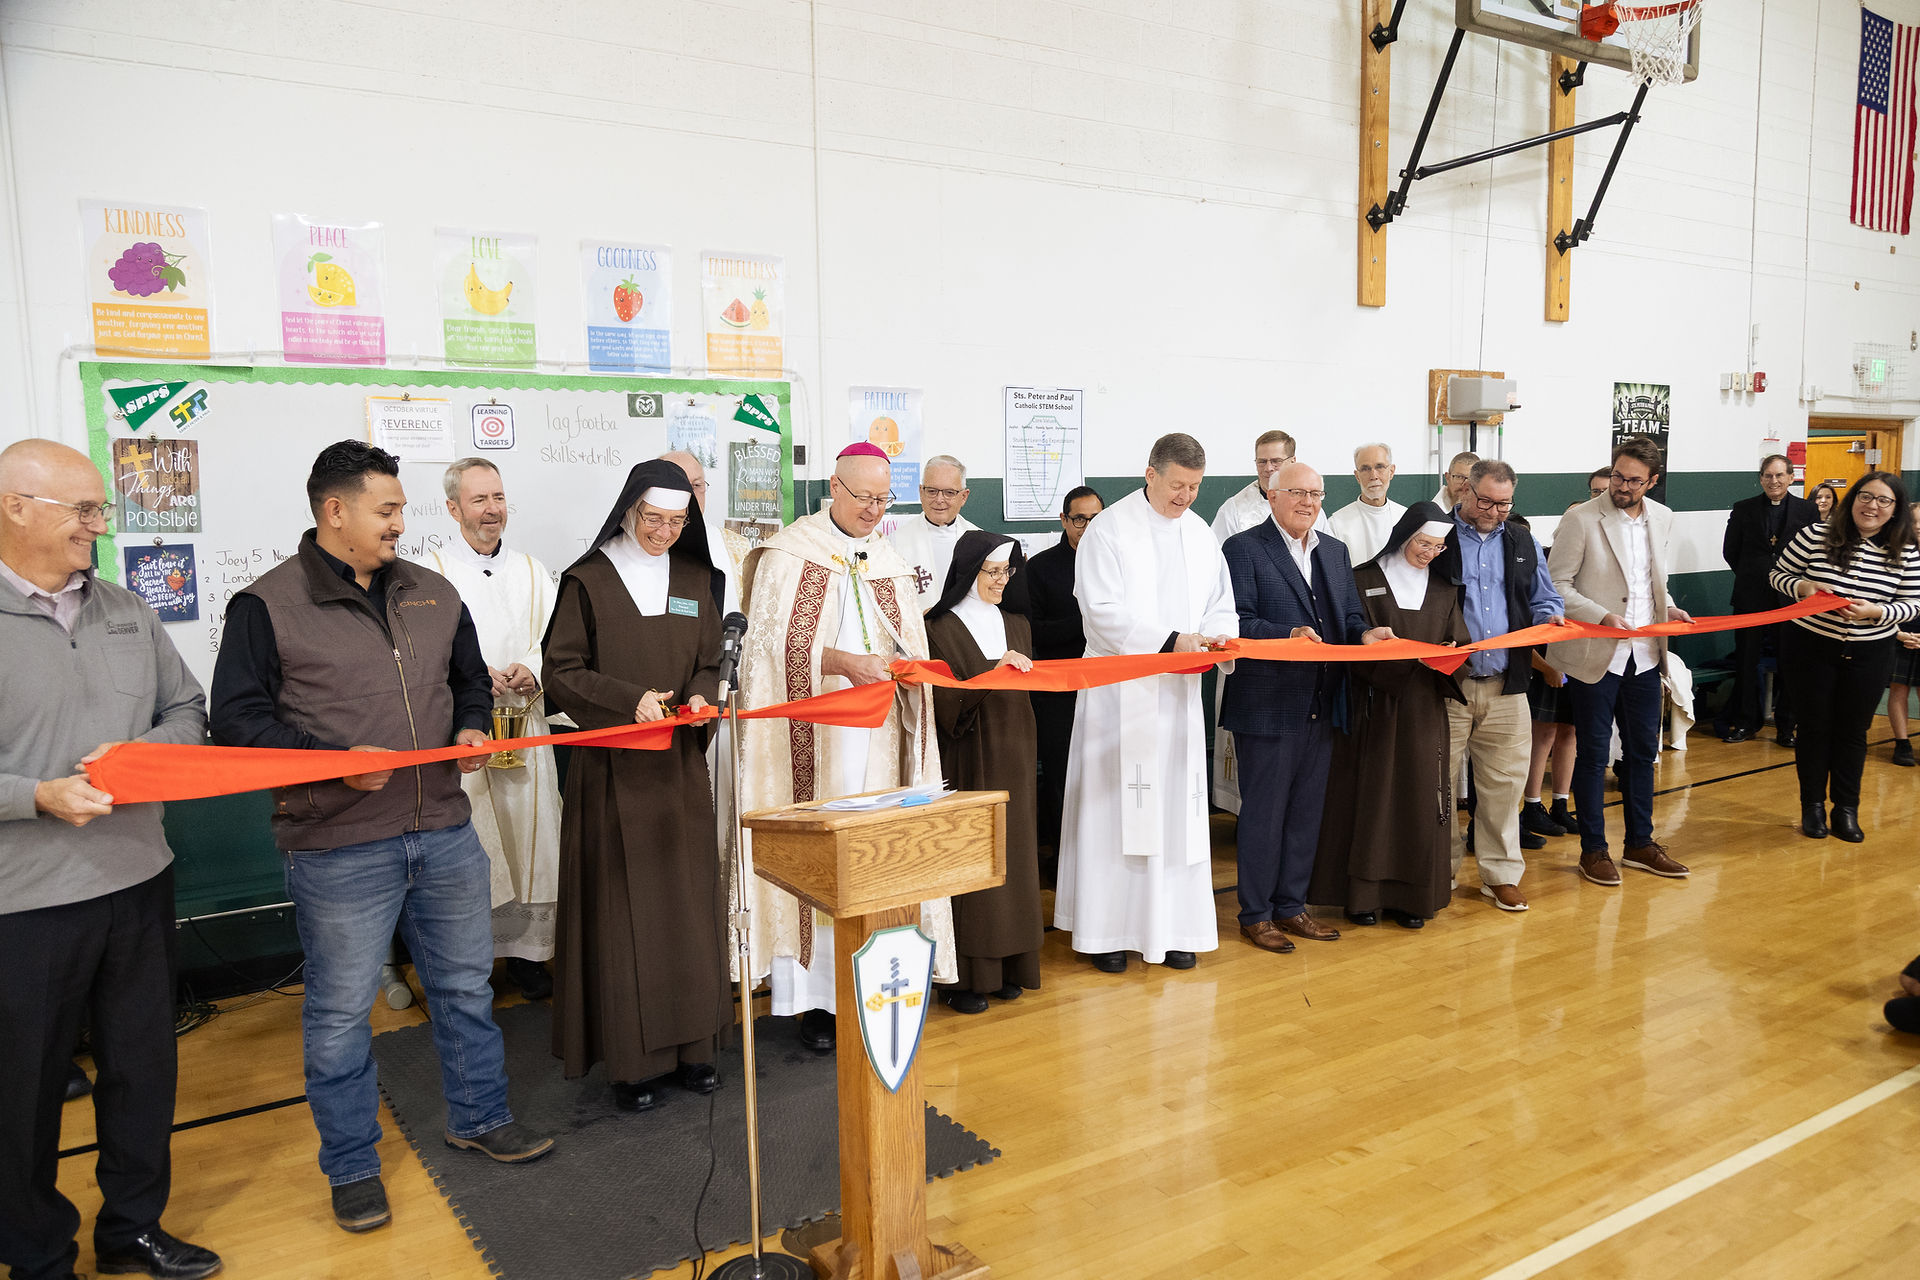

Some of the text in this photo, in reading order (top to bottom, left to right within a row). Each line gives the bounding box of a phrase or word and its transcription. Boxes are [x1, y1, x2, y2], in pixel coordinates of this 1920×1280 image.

[104, 207, 186, 239] KINDNESS
[308, 224, 349, 249] PEACE
[471, 236, 503, 260] LOVE
[597, 246, 658, 272] GOODNESS
[96, 308, 104, 316] Be
[125, 385, 170, 414] SPPS
[864, 391, 908, 411] PATIENCE
[1028, 392, 1046, 400] Peter
[742, 403, 774, 426] SPPS
[381, 419, 443, 429] REVERENCE
[1621, 420, 1661, 435] TEAM
[154, 445, 193, 473] With
[734, 445, 781, 462] BLESSED
[118, 469, 176, 508] Things
[411, 498, 443, 517] with
[735, 502, 780, 512] UNDER TRIAL
[740, 527, 760, 537] LORD
[138, 558, 185, 577] Just leave it
[216, 550, 249, 572] Joey
[139, 576, 165, 592] Sacred
[183, 593, 196, 606] joy
[208, 593, 215, 602] 3
[210, 628, 218, 640] 2
[210, 641, 219, 652] 3
